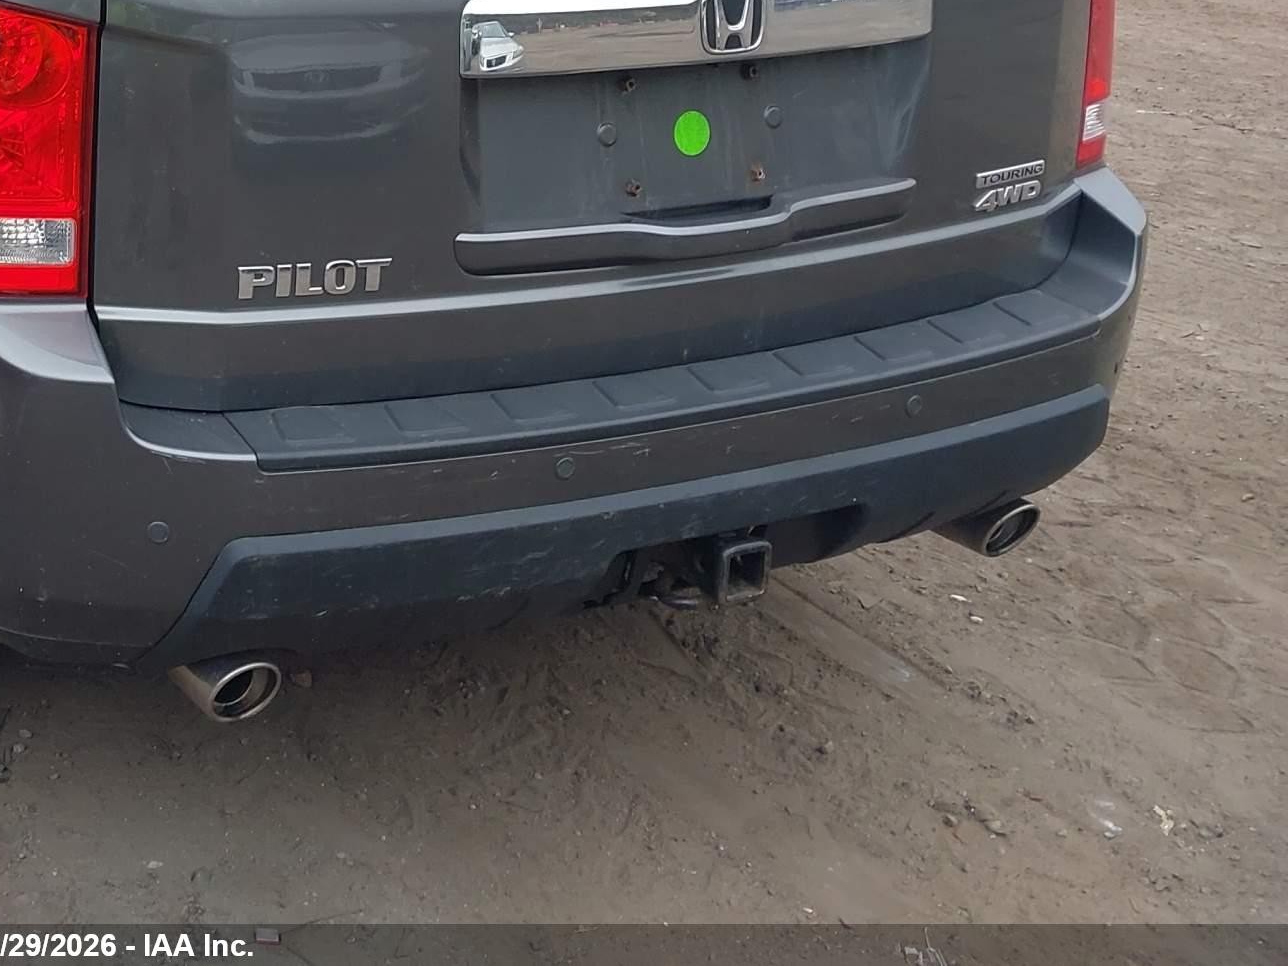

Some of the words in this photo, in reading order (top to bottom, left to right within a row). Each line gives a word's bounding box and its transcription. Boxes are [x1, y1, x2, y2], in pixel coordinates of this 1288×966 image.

[980, 164, 1044, 185] TOURING
[974, 180, 1041, 212] 4WD
[237, 258, 393, 299] PILOT
